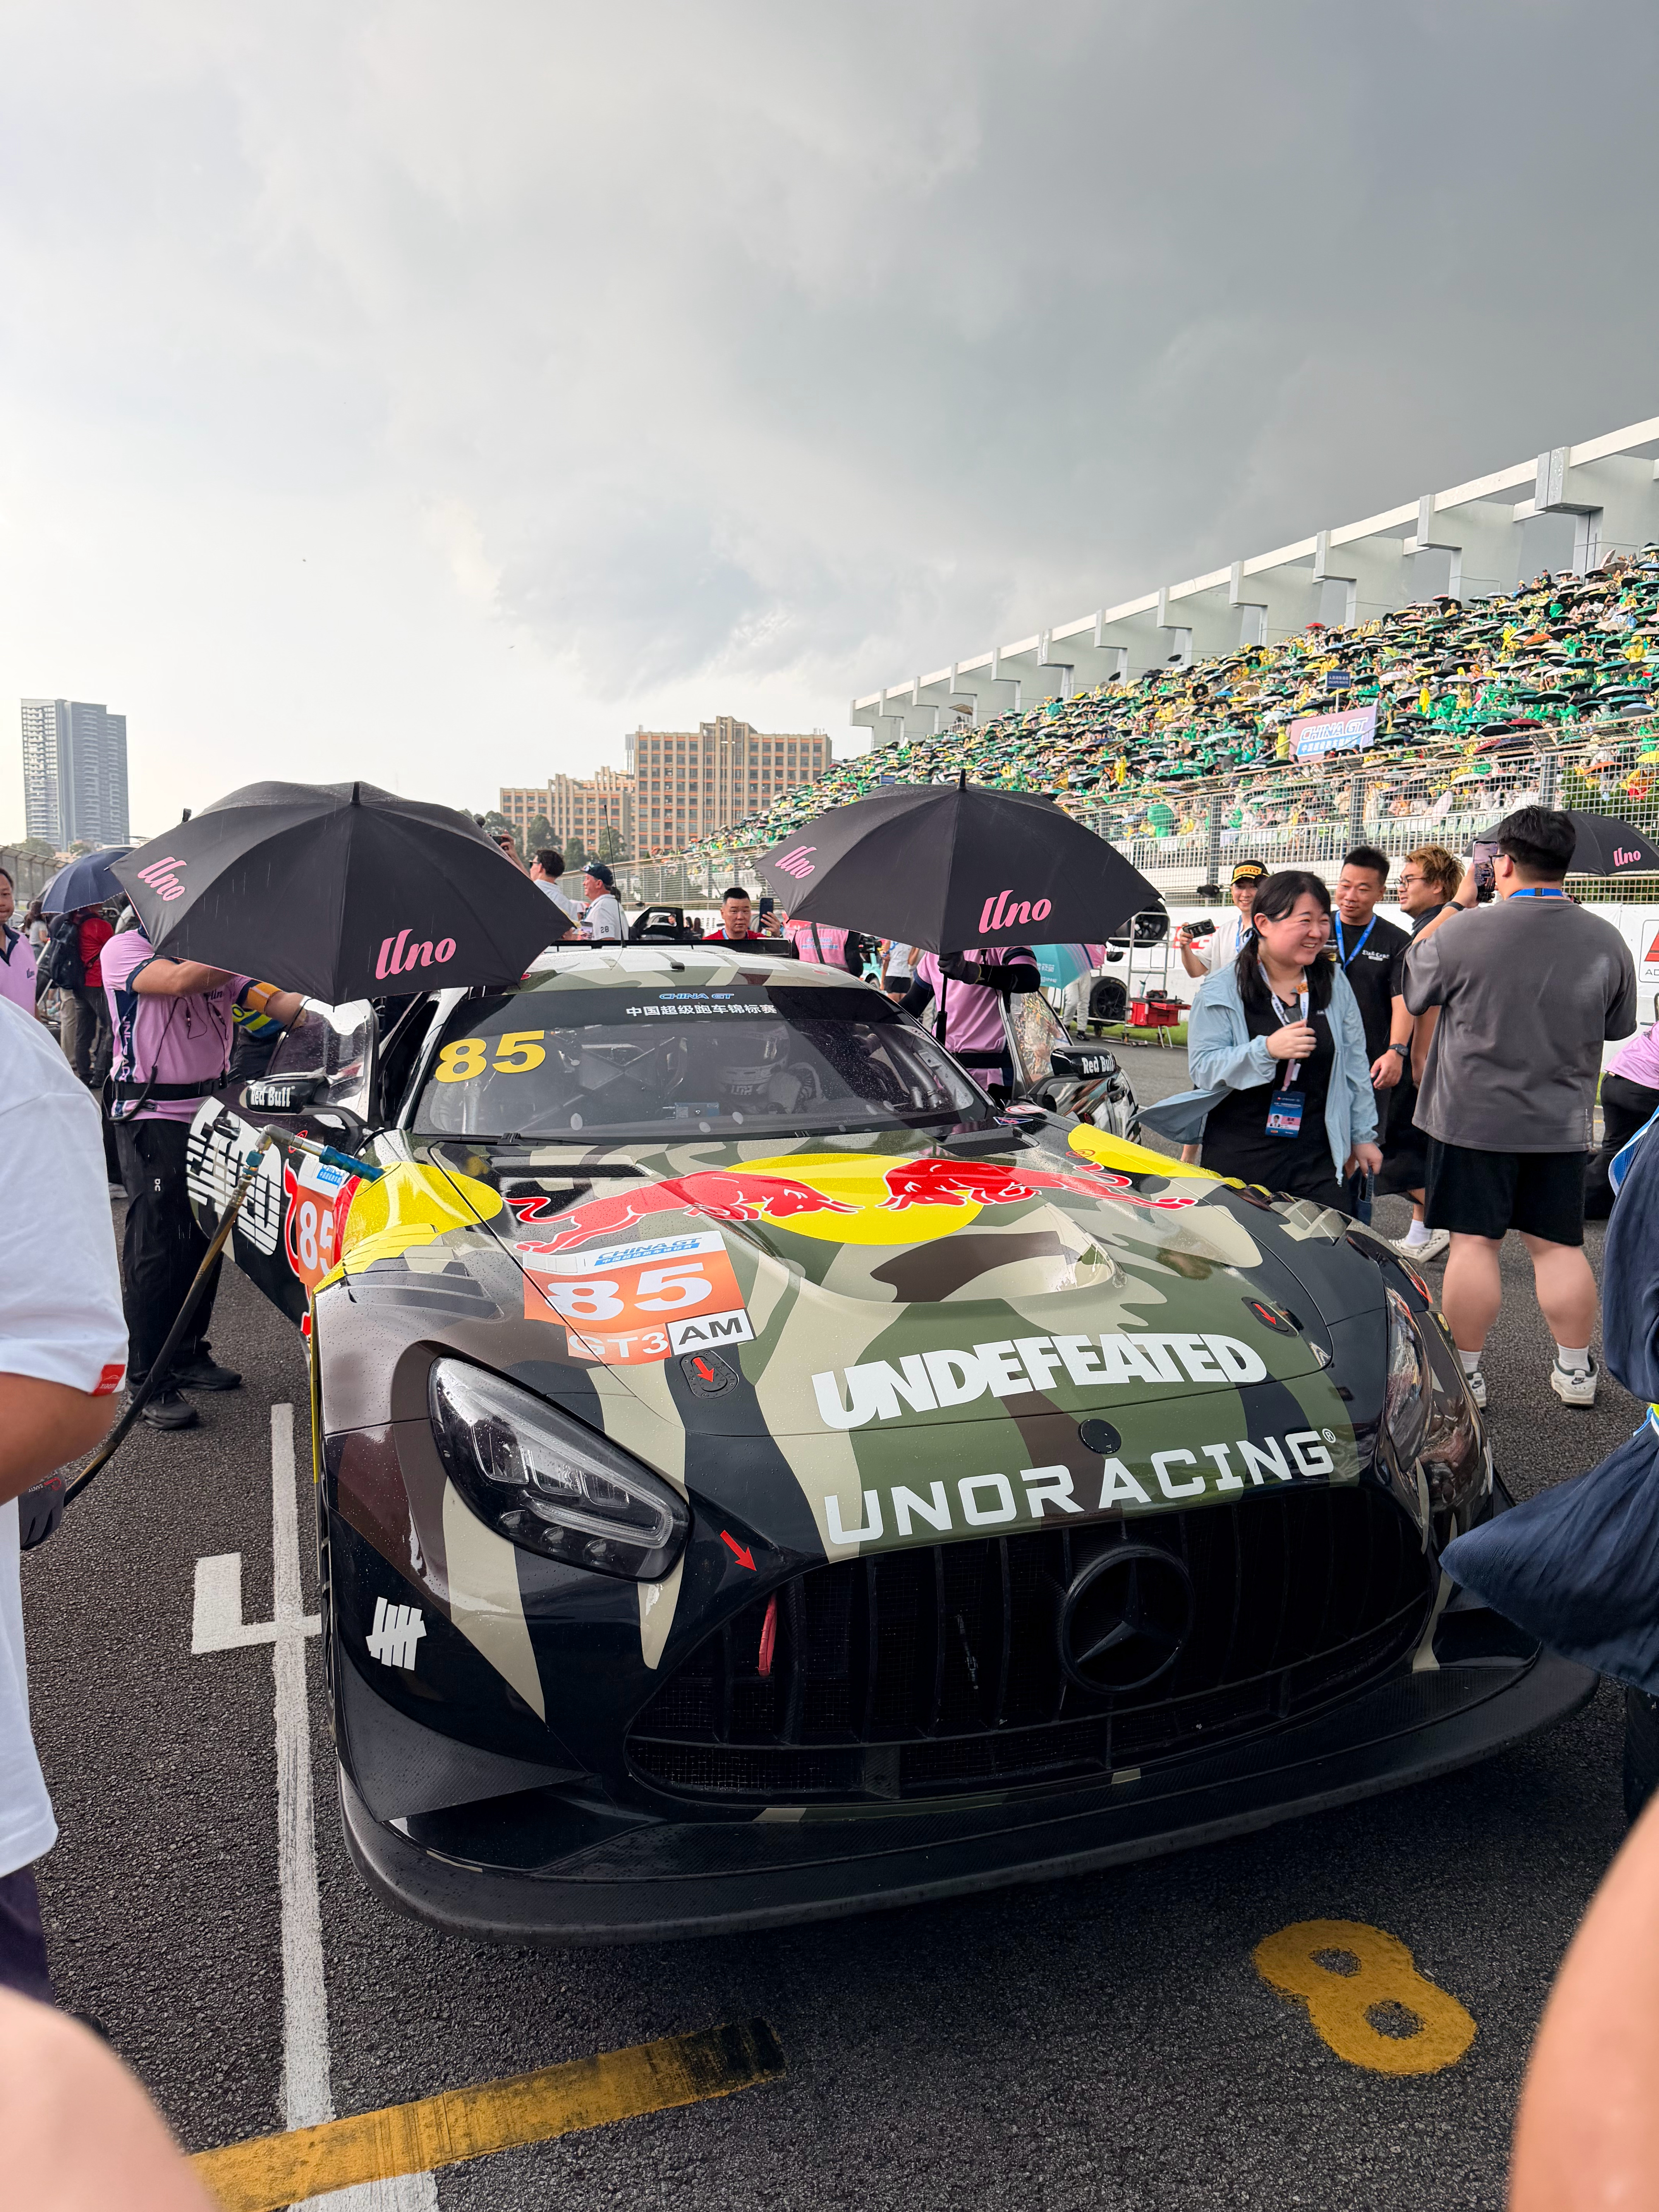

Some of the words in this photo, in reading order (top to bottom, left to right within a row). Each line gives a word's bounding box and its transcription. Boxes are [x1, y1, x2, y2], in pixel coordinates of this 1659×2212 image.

[1300, 721, 1344, 742] CHINA
[1345, 717, 1368, 735] GT
[775, 846, 817, 879] Uno
[1613, 847, 1641, 867] Uno
[137, 857, 187, 901] Uno
[979, 890, 1051, 934] Uno
[375, 929, 457, 980] Uno
[626, 1004, 778, 1017] 中国超级跑车锦标赛
[435, 1030, 546, 1083] 85
[1082, 1056, 1099, 1074] Red
[1099, 1055, 1114, 1072] Bull
[251, 1086, 267, 1106] Red
[268, 1086, 290, 1107] Bull
[300, 1201, 334, 1275] 85
[598, 1243, 667, 1259] CHINA
[672, 1238, 702, 1246] GT
[544, 1262, 713, 1321] 85
[568, 1332, 669, 1357] GT3
[678, 1317, 743, 1345] AM
[811, 1333, 1267, 1429] UNDEFEATED
[1252, 1919, 1477, 2076] 8
